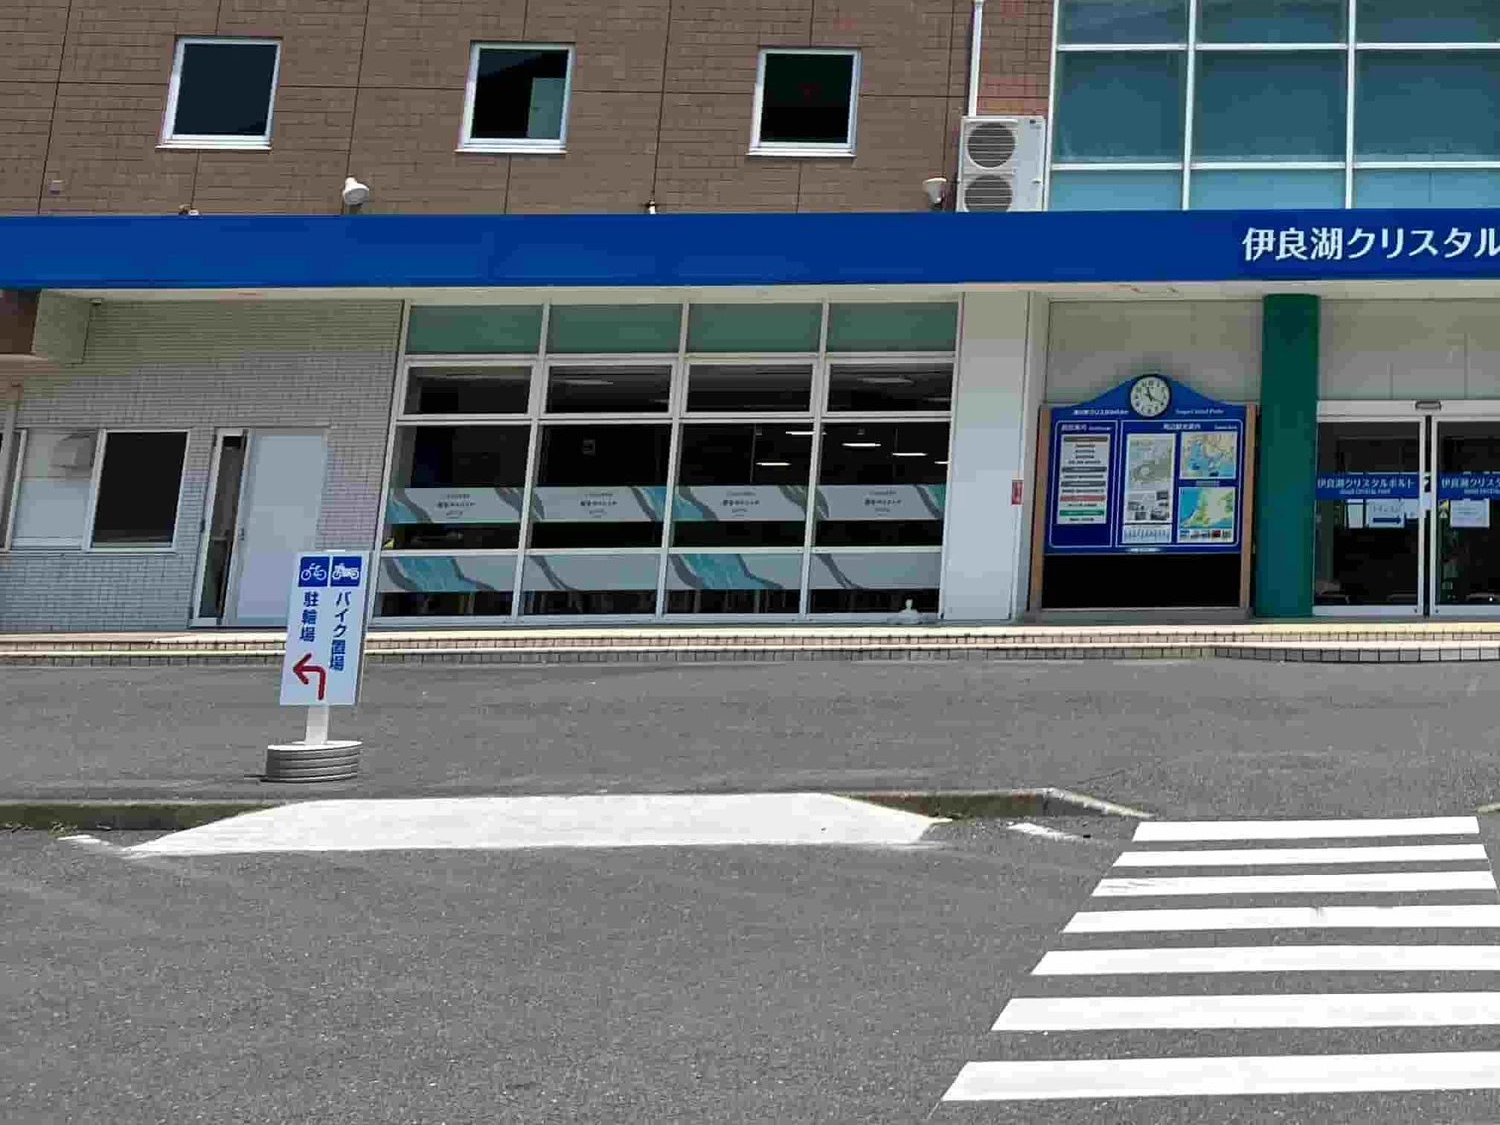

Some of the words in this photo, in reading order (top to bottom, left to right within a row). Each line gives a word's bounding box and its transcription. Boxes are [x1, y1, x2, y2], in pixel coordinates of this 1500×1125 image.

[299, 590, 320, 643] 駐輪場
[329, 590, 353, 672] バイク置場
